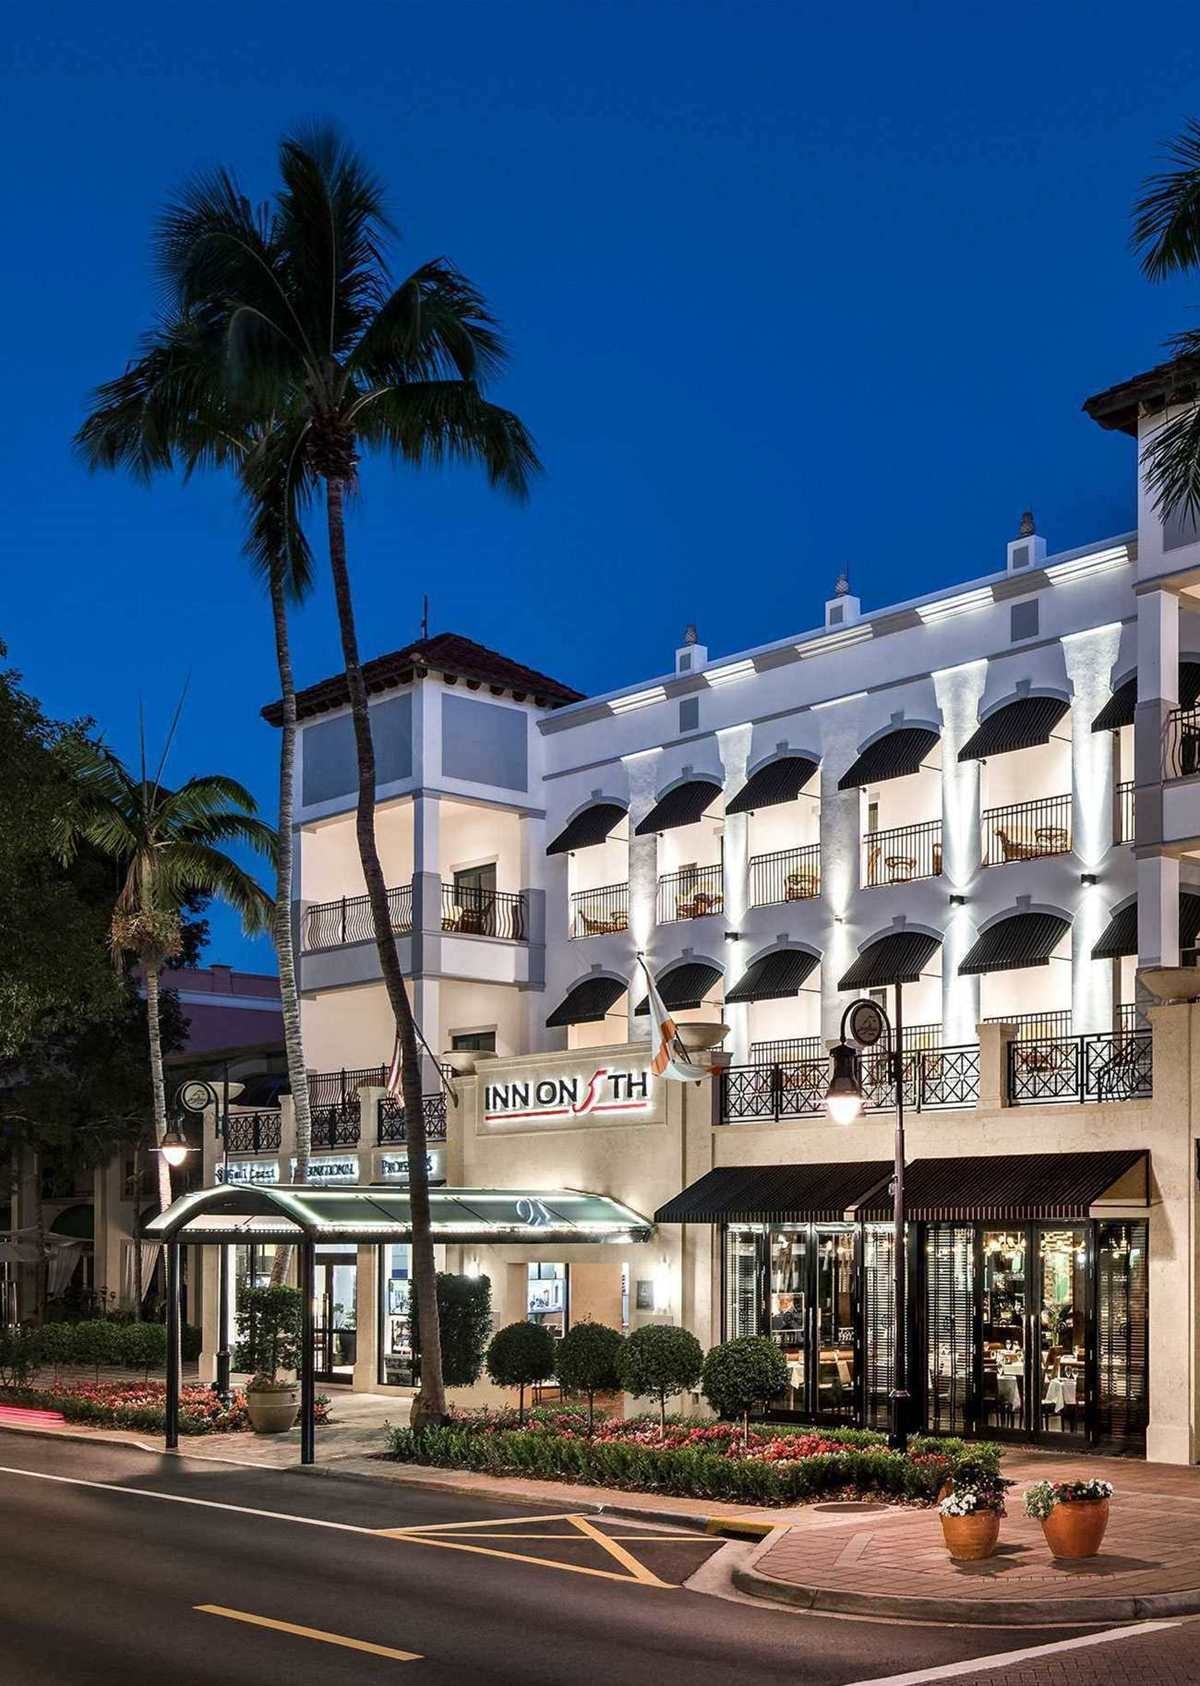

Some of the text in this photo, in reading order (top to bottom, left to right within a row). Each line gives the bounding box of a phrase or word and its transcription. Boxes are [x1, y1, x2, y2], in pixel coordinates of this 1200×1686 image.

[485, 1069, 648, 1113] INN ON 5TH
